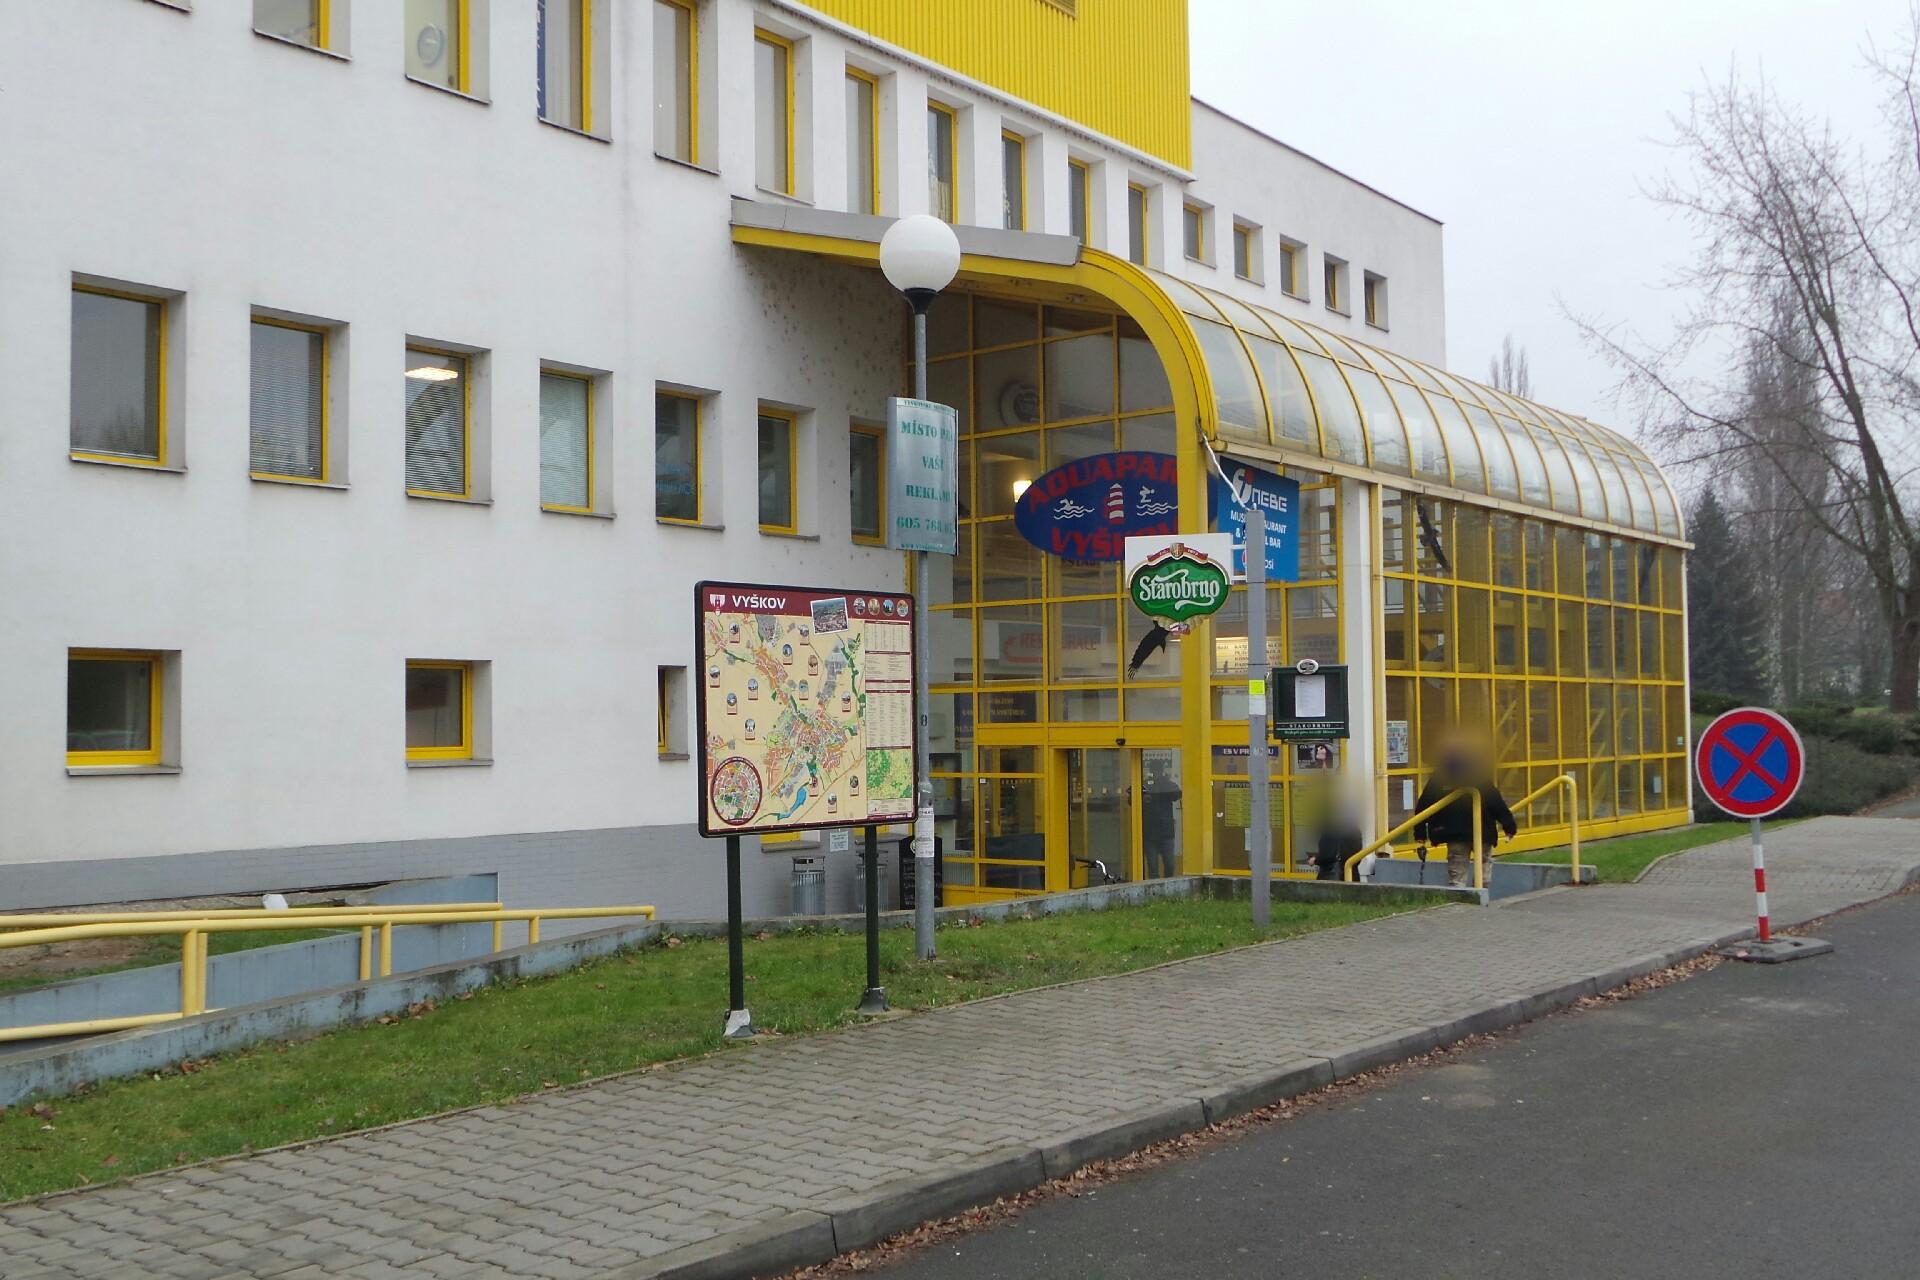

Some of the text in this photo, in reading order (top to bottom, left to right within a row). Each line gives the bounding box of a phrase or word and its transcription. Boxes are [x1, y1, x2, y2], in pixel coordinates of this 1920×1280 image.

[901, 420, 937, 438] MÍSTO
[1029, 455, 1178, 513] AQUAPAR
[896, 516, 920, 529] 605
[1269, 538, 1281, 549] BAR
[1139, 568, 1220, 611] Starobrno
[732, 593, 786, 610] VYŠKOV
